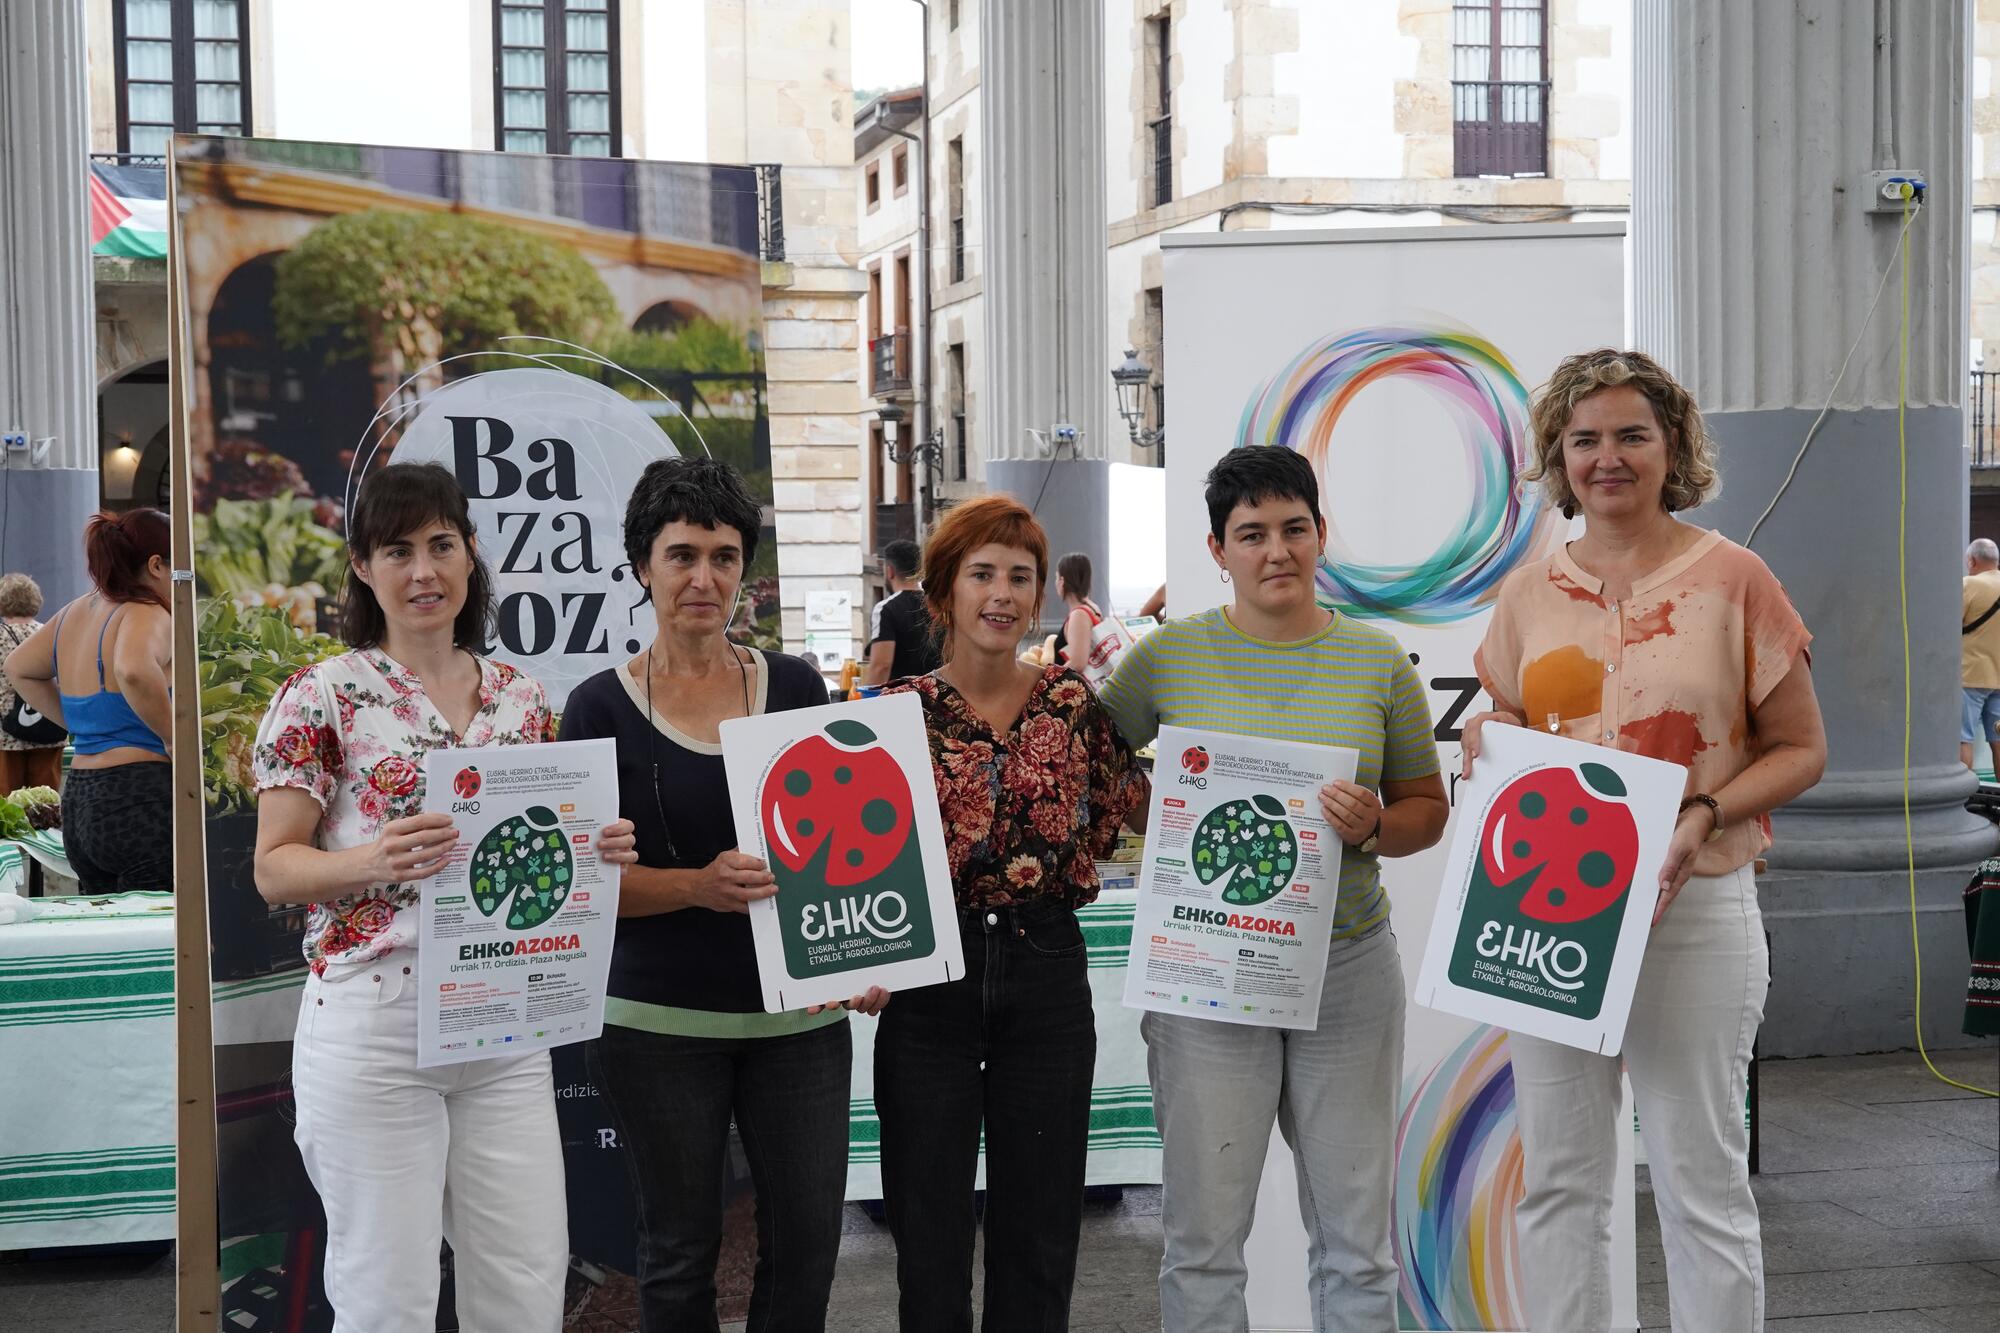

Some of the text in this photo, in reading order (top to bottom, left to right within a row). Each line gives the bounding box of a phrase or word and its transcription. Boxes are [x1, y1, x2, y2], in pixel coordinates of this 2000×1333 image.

[444, 415, 583, 501] Ba
[497, 511, 603, 574] za
[475, 563, 653, 657] oz?
[486, 766, 558, 778] EUSKAL HERRIKO ETXALDE
[1214, 760, 1270, 773] AGROEKOLOGIKOEN
[1271, 767, 1324, 780] IDENTIFIKATZAILEA
[1215, 753, 1290, 770] EUSKAL HERRIKO ETXALDE
[486, 771, 590, 785] AGROEKOLOGIKOEN IDENTIFIKATZAILEA
[1178, 775, 1207, 790] EHKO
[451, 801, 481, 815] EHKO
[800, 890, 913, 941] EHKO
[1172, 905, 1296, 936] EHKOAZOKA
[808, 937, 872, 957] EUSKAL HERRIKO
[1162, 920, 1192, 933] Urriak
[1205, 926, 1240, 940] Ordizia.
[1241, 931, 1266, 944] Plaza
[1268, 935, 1302, 948] Nagusia
[459, 934, 580, 961] EHKOAZOKA
[809, 939, 912, 966] ETXALDE AGROEKOLOGIKOA
[1475, 919, 1588, 990] EHKO
[450, 960, 479, 972] Urriak
[494, 957, 528, 968] Ordizia.
[530, 954, 553, 965] Plaza
[555, 950, 587, 963] Nagusia
[1474, 959, 1540, 984] EUSKAL HERRIKO
[1472, 970, 1578, 1005] ETXALDE AGROEKOLOGIKOA
[557, 1083, 600, 1099] rdizia
